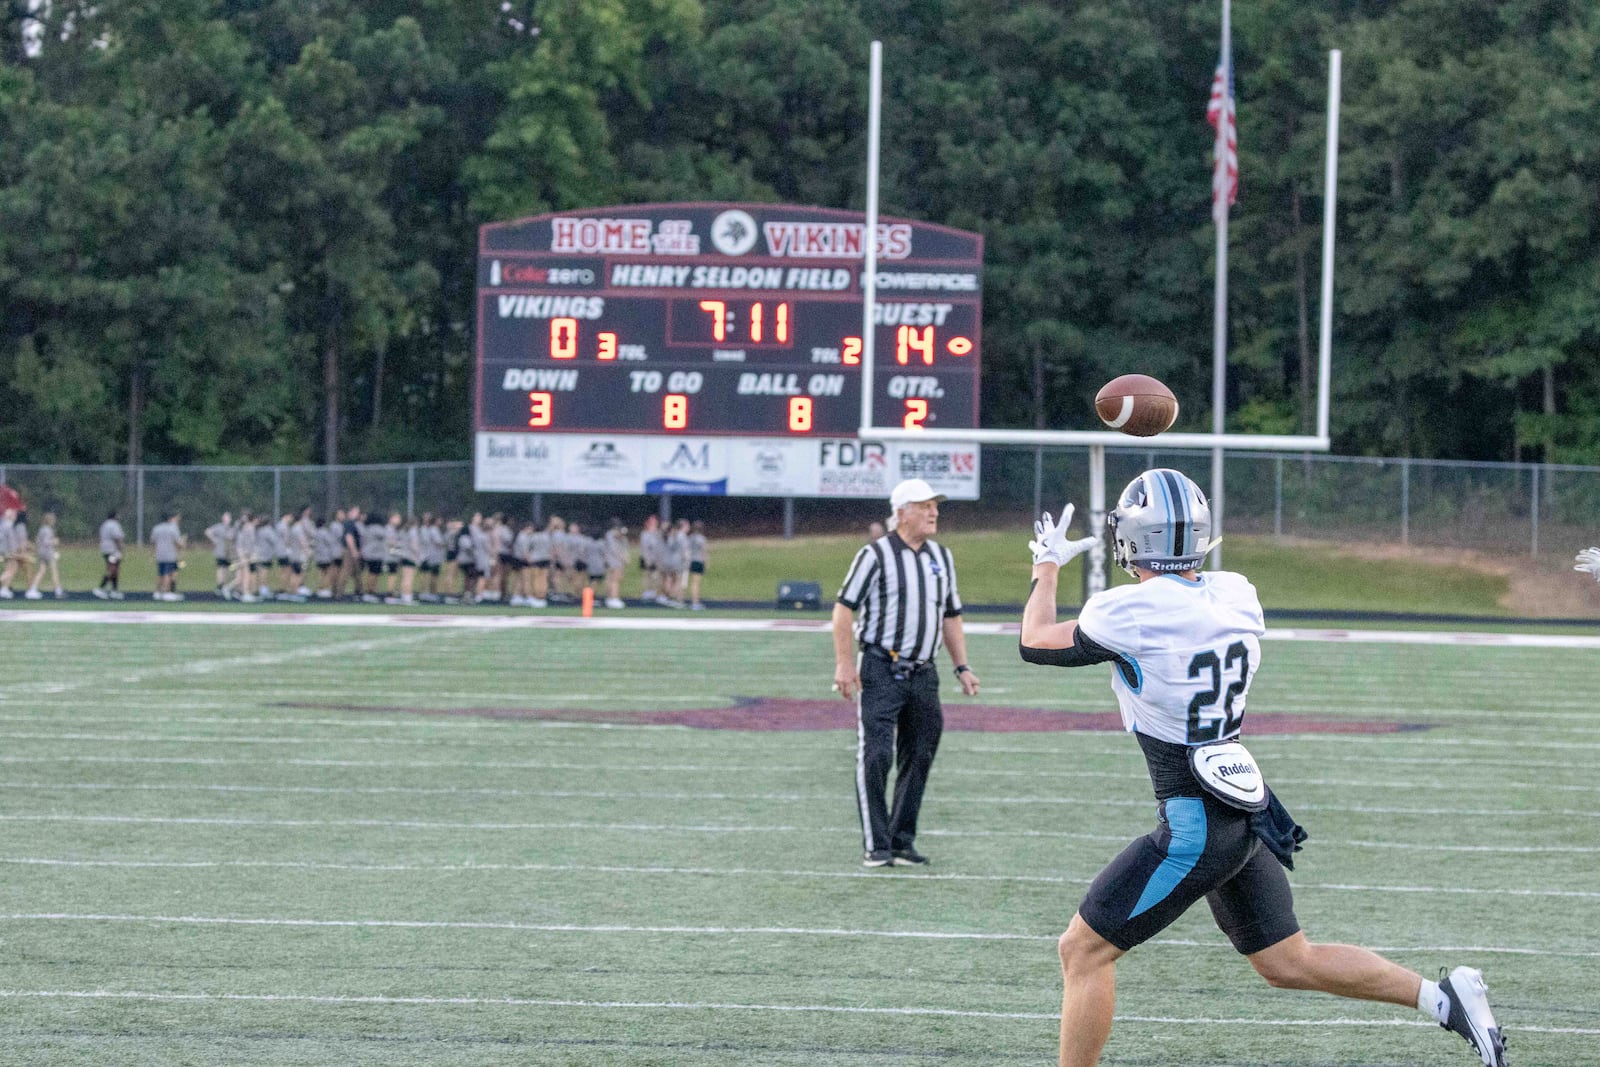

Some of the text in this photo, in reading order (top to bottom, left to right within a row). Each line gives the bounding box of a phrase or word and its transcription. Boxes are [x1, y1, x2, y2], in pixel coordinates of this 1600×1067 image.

[551, 218, 653, 255] HOME
[658, 219, 692, 235] OF
[652, 235, 701, 256] THE
[547, 267, 595, 285] zero
[611, 264, 851, 291] HENRY SELDON FIELD
[497, 294, 605, 320] VIKINGS
[699, 300, 788, 342] 7:11
[550, 317, 578, 360] 0
[597, 331, 617, 361] 3
[841, 335, 863, 366] 2
[897, 324, 934, 366] 14
[503, 368, 579, 391] DOWN
[629, 370, 704, 394] TO GO
[736, 373, 845, 397] BALL ON
[887, 376, 945, 399] QTR.
[528, 391, 552, 427] 3
[663, 393, 688, 429] 8
[788, 396, 813, 432] 8
[903, 398, 928, 430] 2
[1130, 541, 1138, 554] 6
[1150, 560, 1199, 571] Riddell
[1186, 640, 1250, 745] 22
[1217, 762, 1256, 777] Riddell
